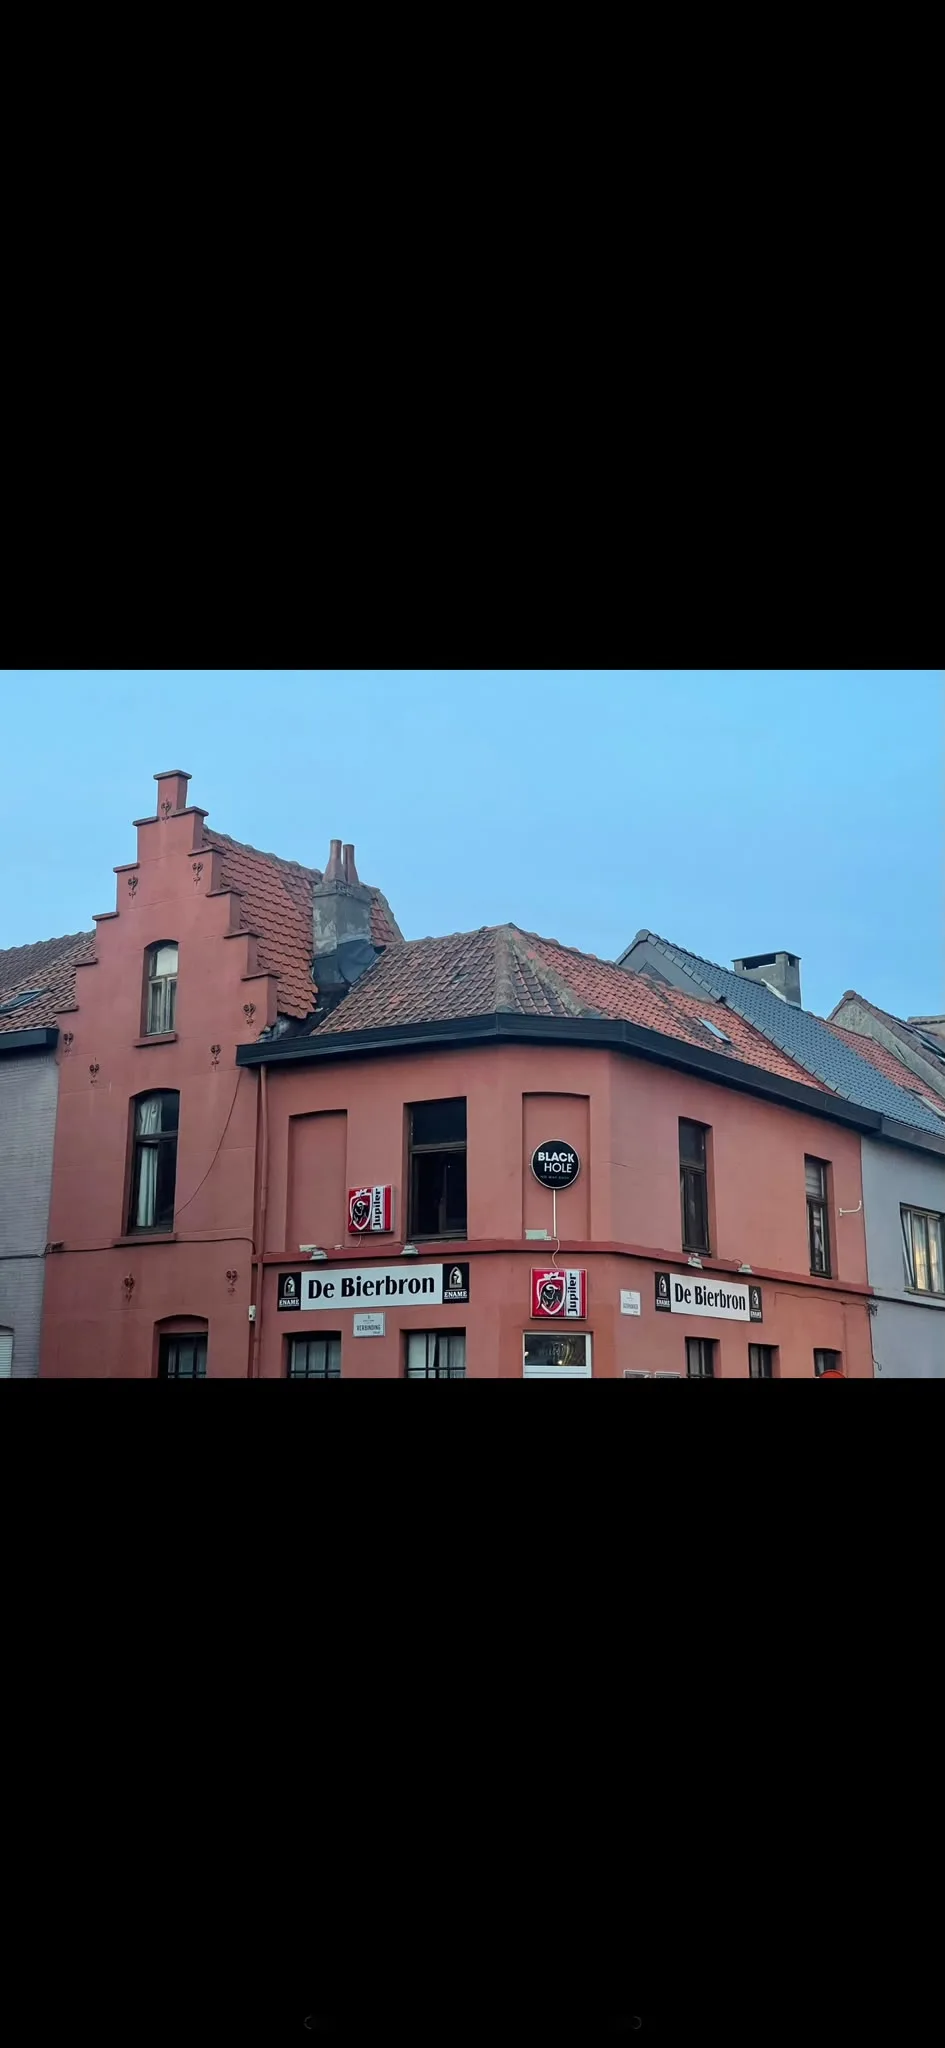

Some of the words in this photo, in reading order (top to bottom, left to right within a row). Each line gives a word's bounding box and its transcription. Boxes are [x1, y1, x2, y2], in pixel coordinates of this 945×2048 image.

[537, 1151, 575, 1163] BLACK
[544, 1162, 572, 1173] HOLE
[373, 1188, 382, 1229] Jupiler
[308, 1279, 335, 1299] De
[341, 1275, 435, 1298] Bierbron
[443, 1290, 468, 1298] ENAME
[567, 1272, 579, 1315] Jupiler
[674, 1282, 692, 1304] De
[694, 1285, 746, 1311] Bierbron
